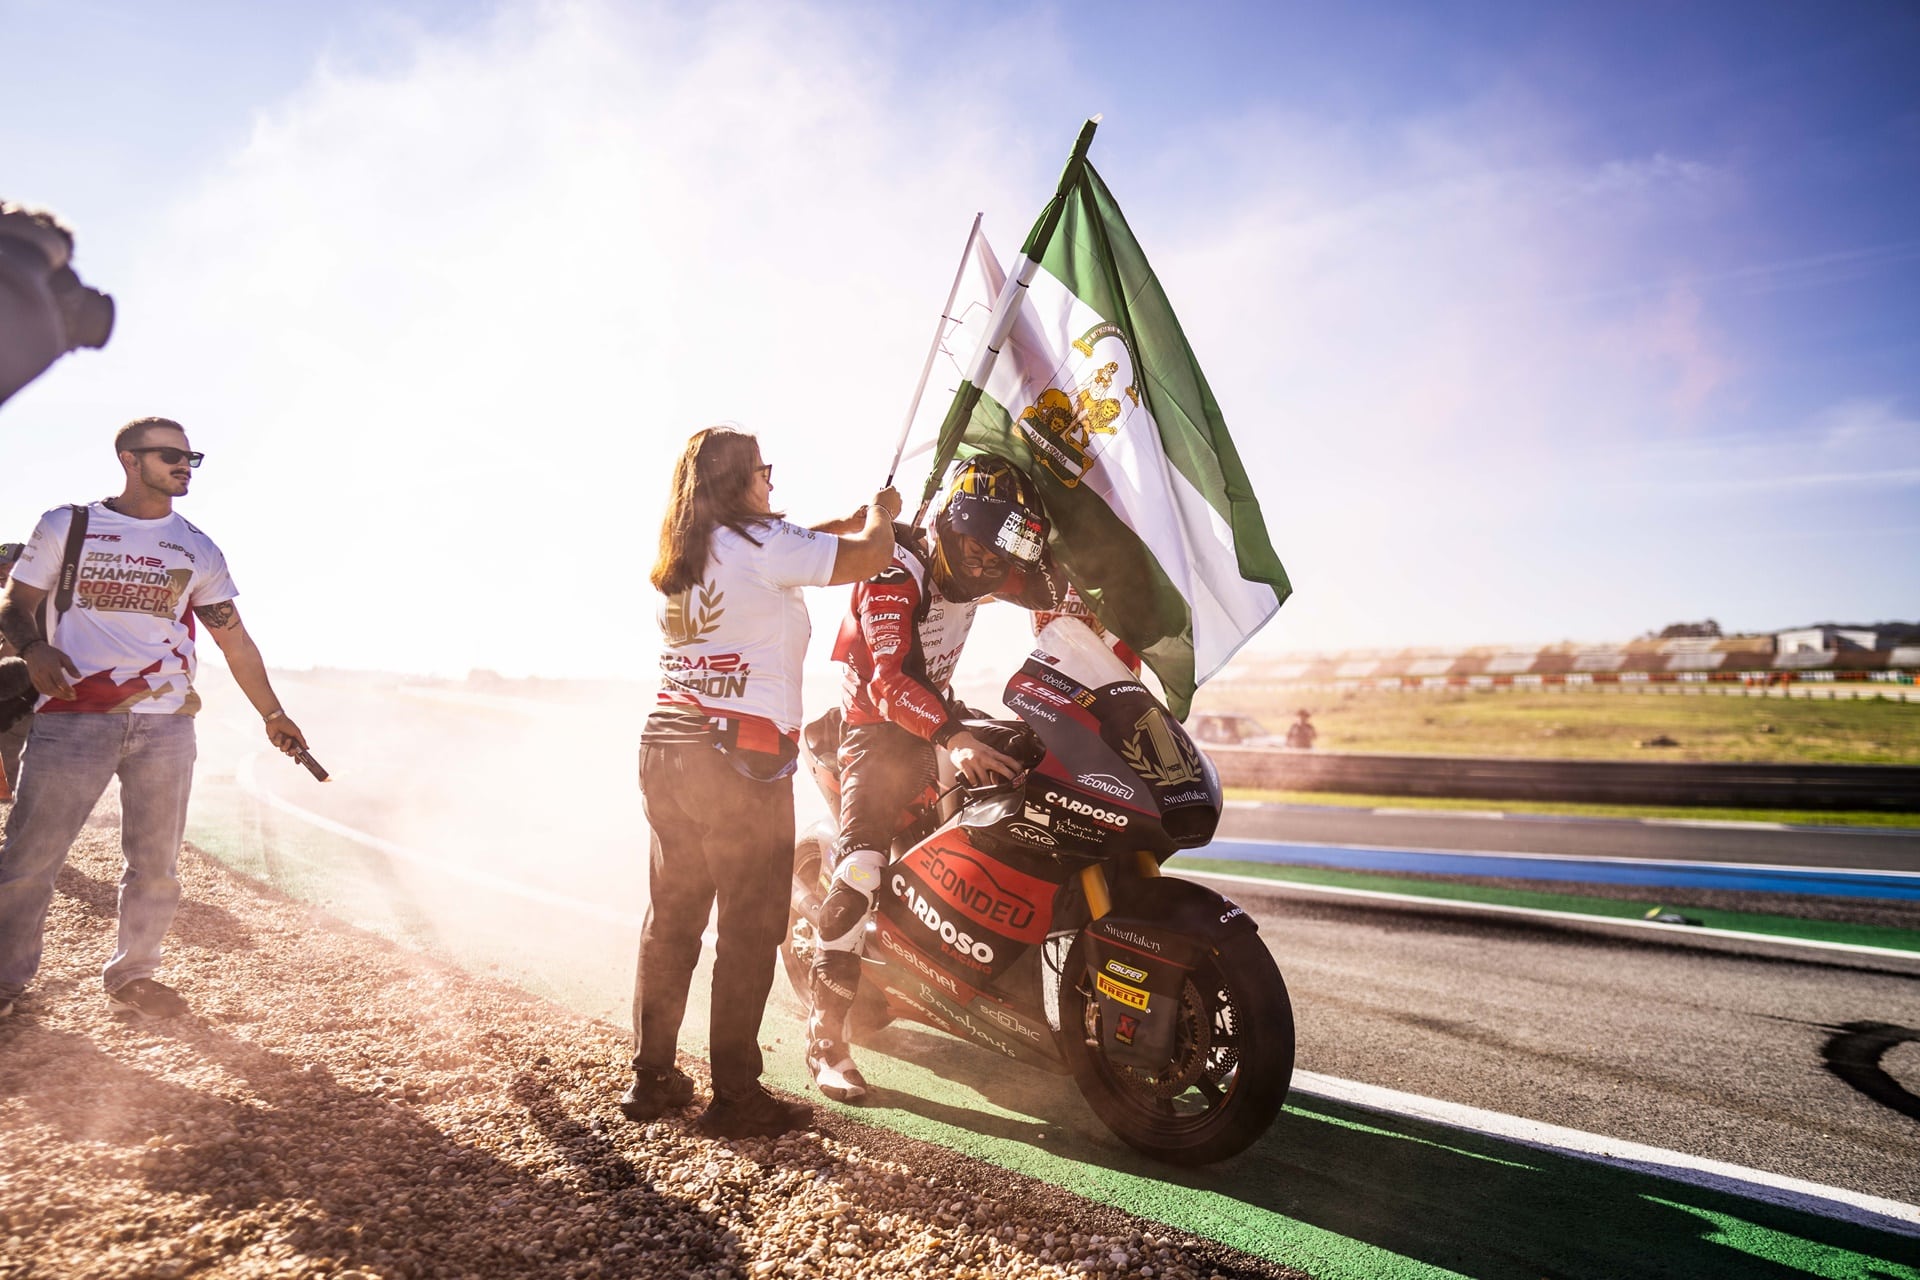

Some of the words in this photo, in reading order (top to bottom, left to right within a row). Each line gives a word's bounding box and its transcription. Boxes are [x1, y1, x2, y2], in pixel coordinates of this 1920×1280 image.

[85, 551, 122, 563] 2024
[80, 566, 170, 587] CHAMPION
[79, 580, 172, 601] ROBERTO
[95, 595, 168, 612] GARCIA
[1021, 682, 1072, 704] LS2
[1083, 777, 1134, 800] CONDEU
[1045, 791, 1128, 827] CARDOSO
[1010, 827, 1055, 845] AMG
[929, 857, 1036, 929] CONDEU
[891, 873, 994, 964] CARDOSO
[1104, 923, 1161, 953] SweetBakery
[881, 930, 959, 996] Seatsnet
[1099, 977, 1145, 1006] PIRELLI
